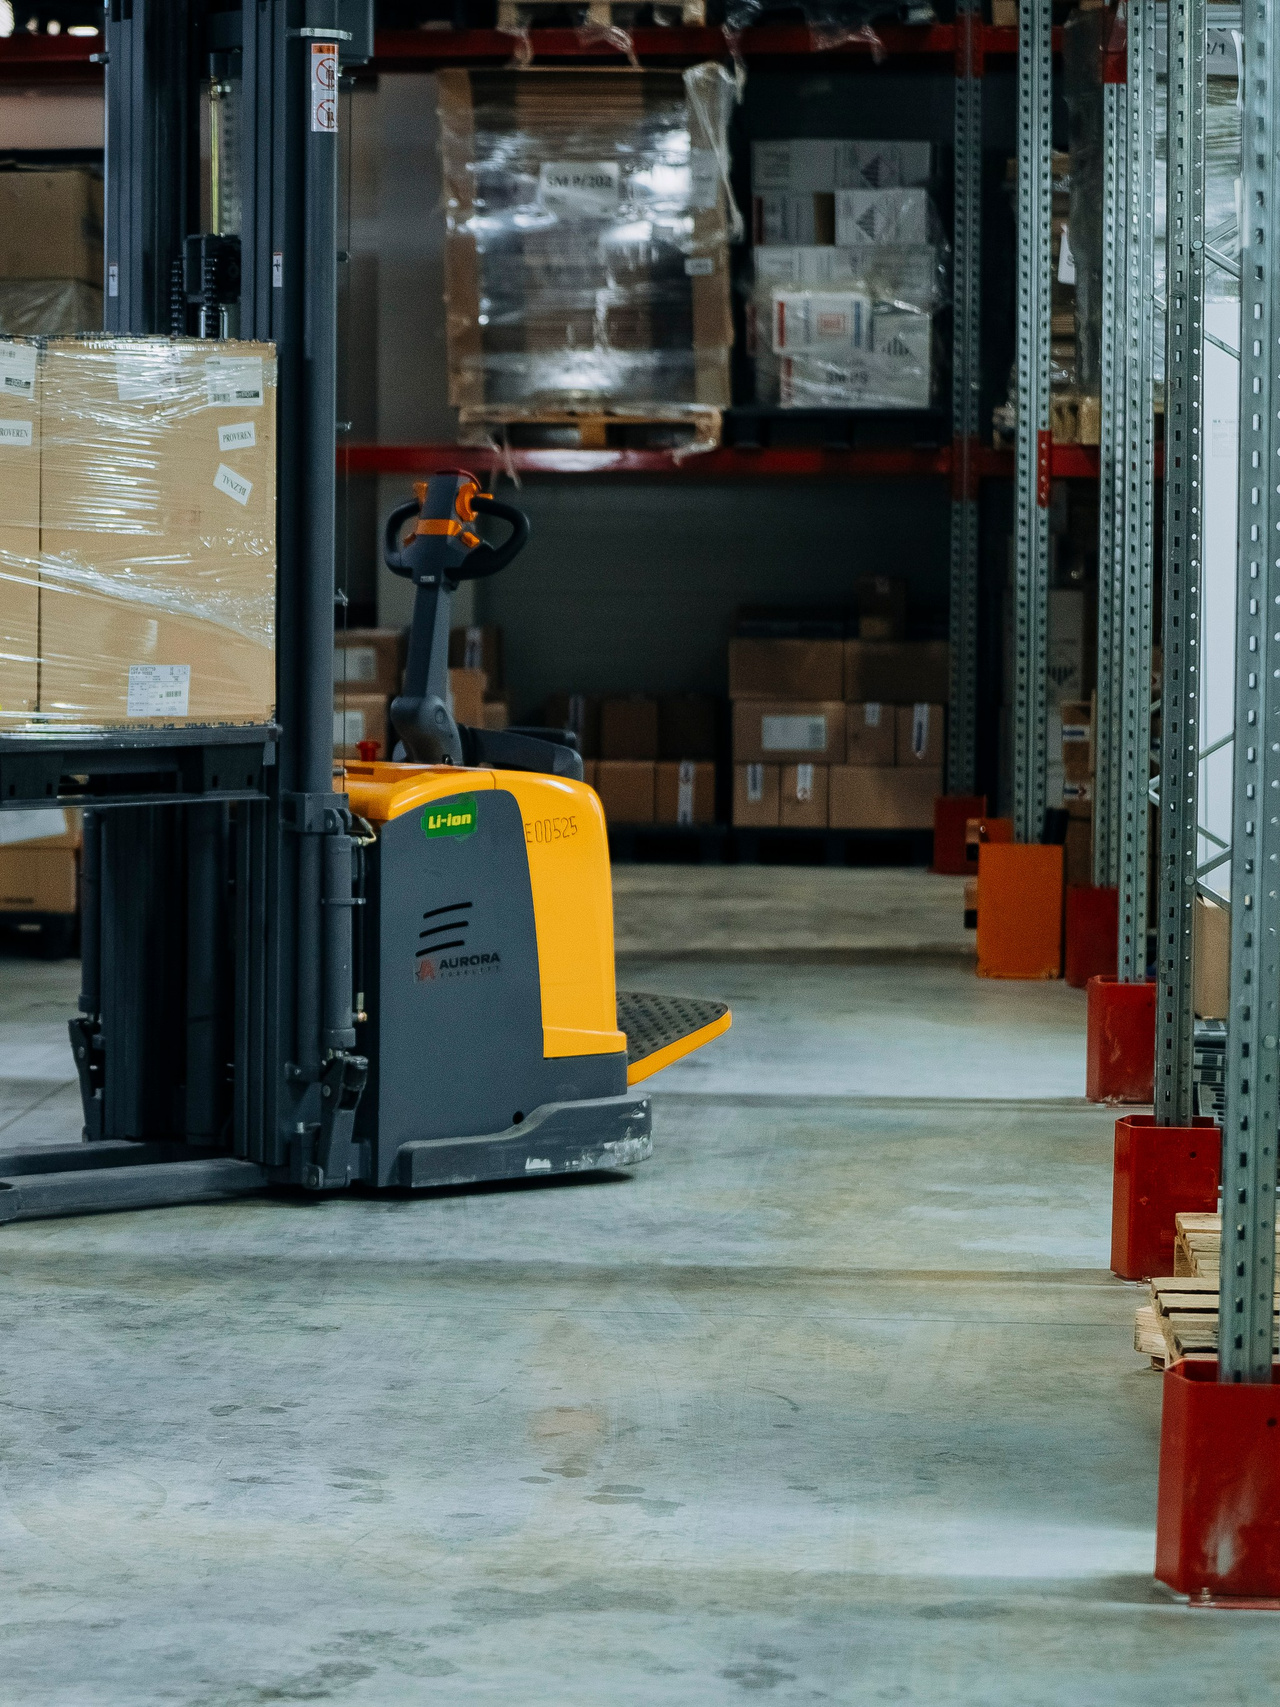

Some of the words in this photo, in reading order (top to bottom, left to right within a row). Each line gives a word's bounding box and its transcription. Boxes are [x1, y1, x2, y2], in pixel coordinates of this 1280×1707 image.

[222, 430, 252, 443] PROVEREN
[428, 813, 472, 830] Li-ion
[439, 952, 500, 970] AURORA
